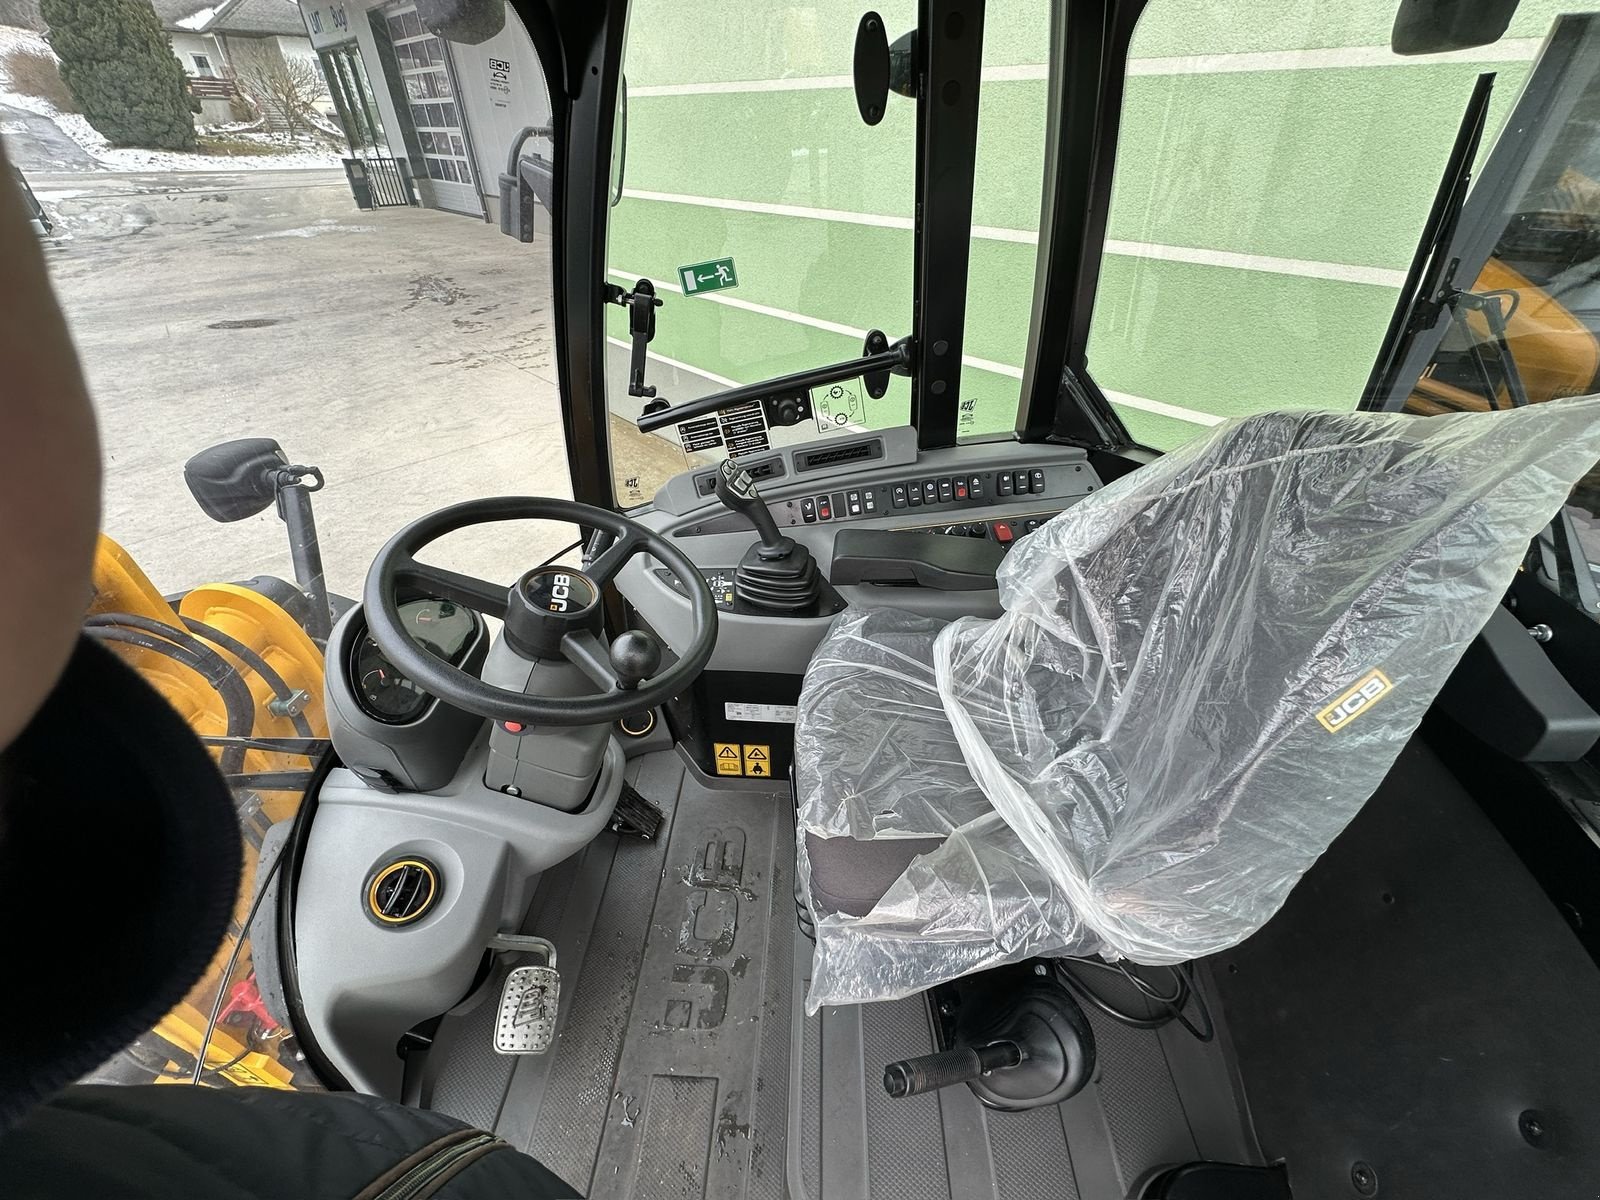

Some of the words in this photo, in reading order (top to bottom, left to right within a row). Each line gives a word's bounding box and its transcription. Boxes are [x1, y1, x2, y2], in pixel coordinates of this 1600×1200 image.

[549, 574, 570, 612] JCB
[1327, 677, 1386, 725] JCB
[664, 826, 747, 1031] JCB
